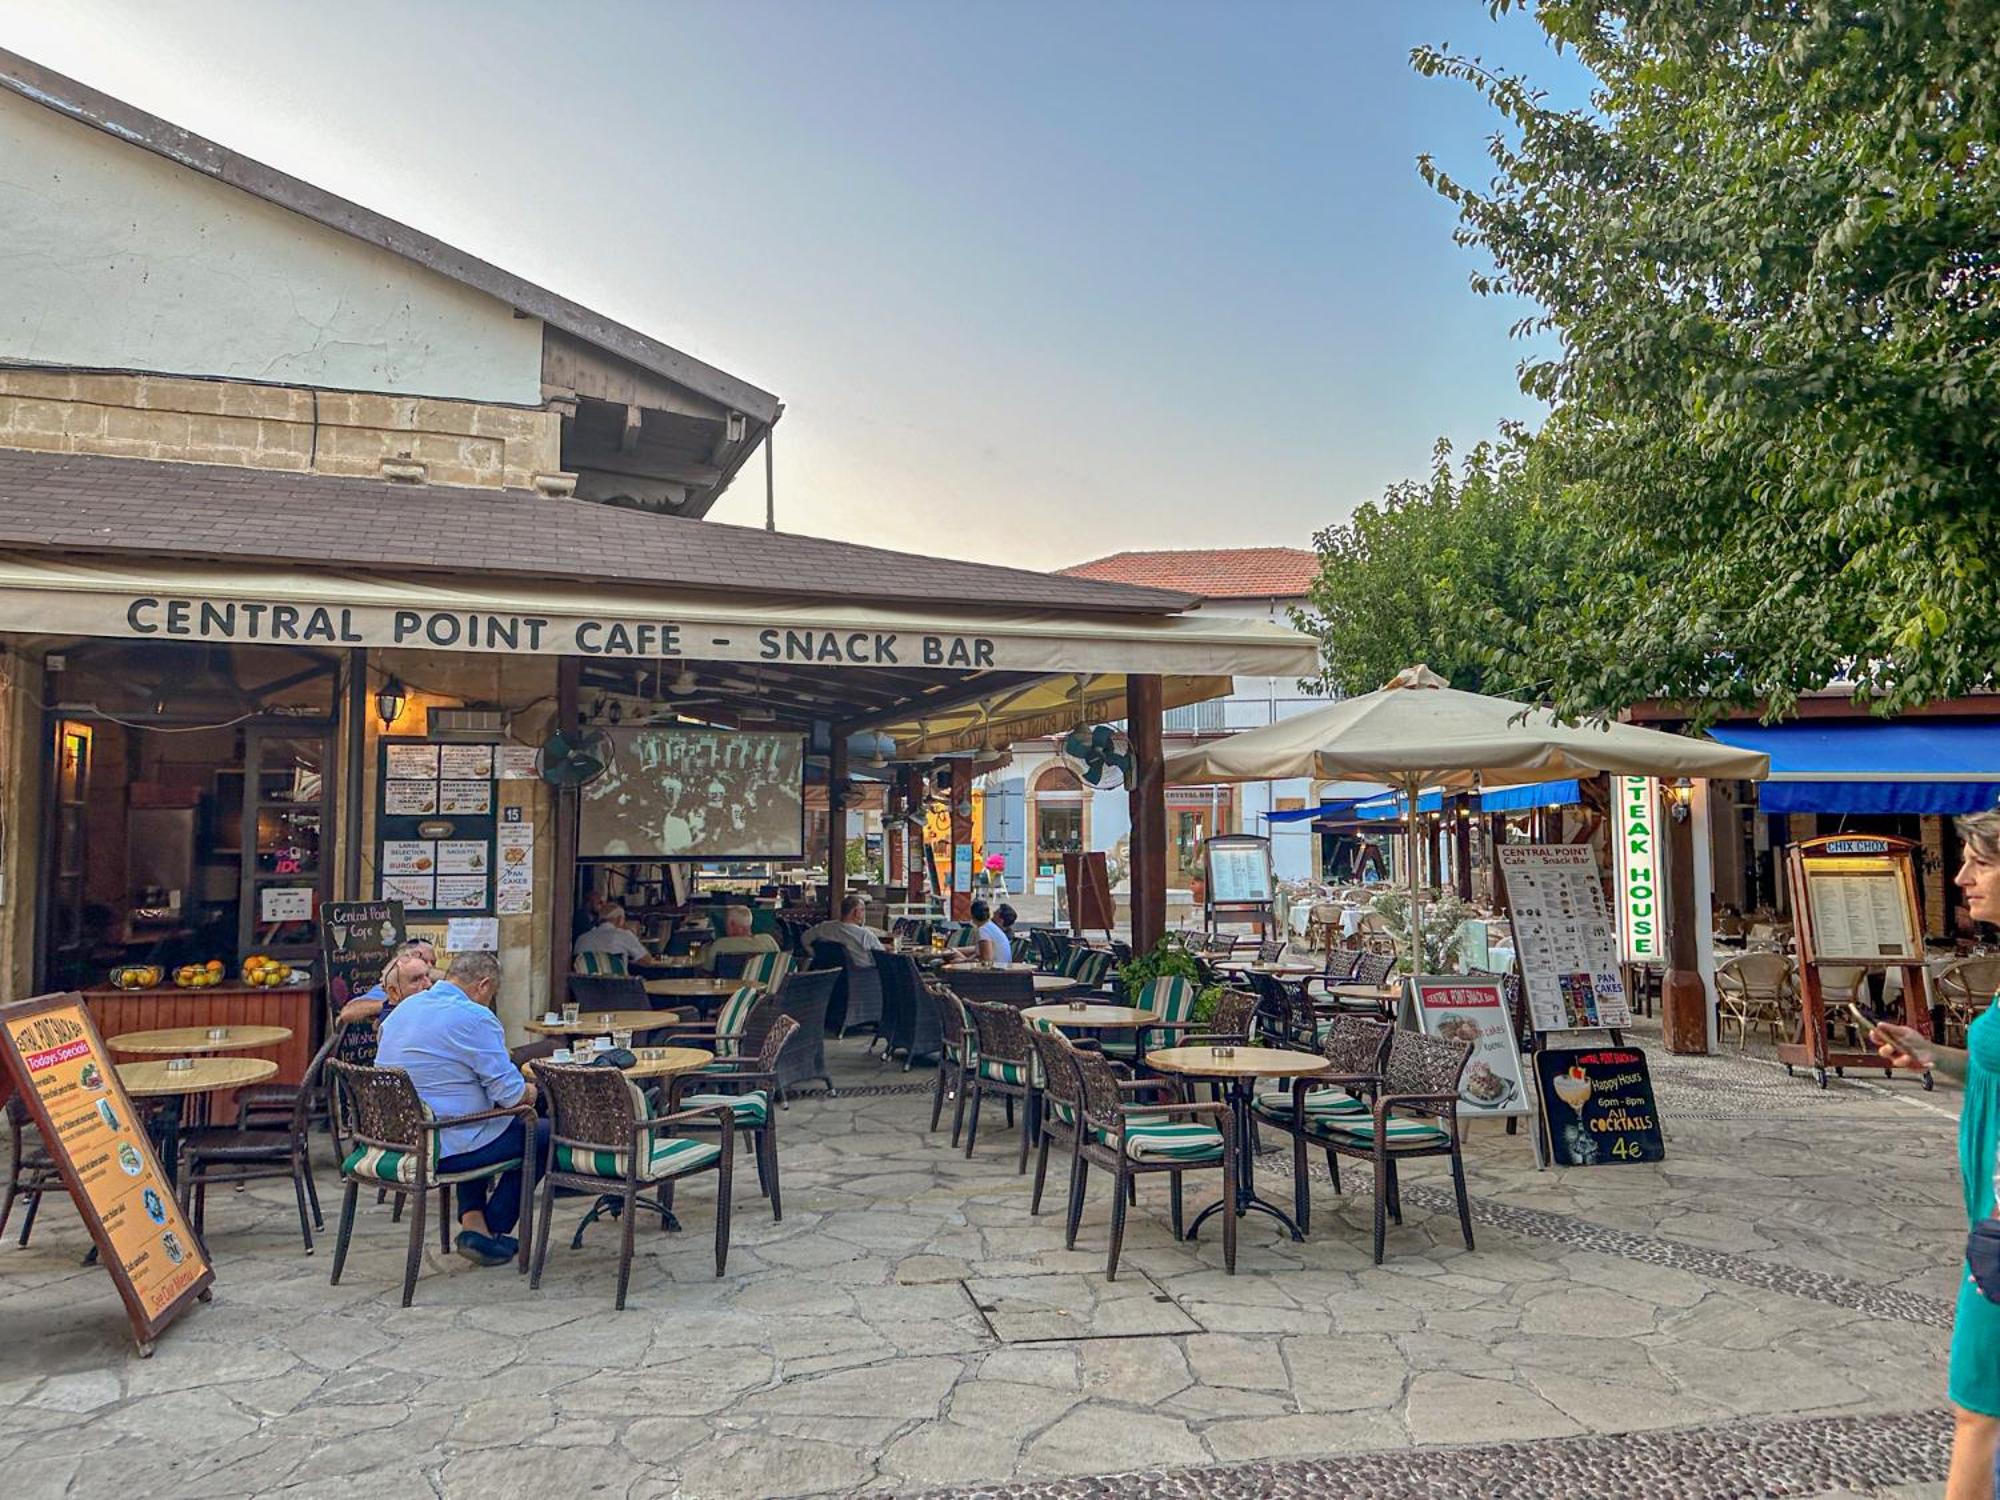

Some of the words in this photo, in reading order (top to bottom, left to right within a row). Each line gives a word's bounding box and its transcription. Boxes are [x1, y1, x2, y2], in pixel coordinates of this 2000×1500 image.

[126, 596, 363, 642] CENTRAL
[394, 609, 549, 651] POINT
[575, 620, 682, 656] CAFE
[759, 627, 899, 664] SNACK
[922, 634, 995, 668] BAR
[506, 809, 519, 820] 15
[1502, 848, 1553, 857] CENTRAL
[1555, 847, 1589, 856] POINT
[1827, 841, 1854, 852] CHIX
[1857, 840, 1886, 851] CHOX
[1504, 857, 1527, 865] Cafe
[1542, 856, 1571, 865] Snack
[1573, 856, 1590, 864] Bar
[333, 907, 367, 923] Central
[1630, 868, 1653, 953] HOUSE
[1597, 974, 1615, 983] PAN
[1595, 984, 1623, 993] CAKES
[28, 1053, 58, 1070] Todays
[57, 1043, 89, 1062] Specials
[1591, 1077, 1618, 1092] Happy
[1617, 1072, 1642, 1086] Hours
[1598, 1097, 1619, 1108] 6pm
[1608, 1108, 1626, 1118] All
[1590, 1115, 1653, 1132] COCKTAILS
[1612, 1136, 1643, 1159] 4€
